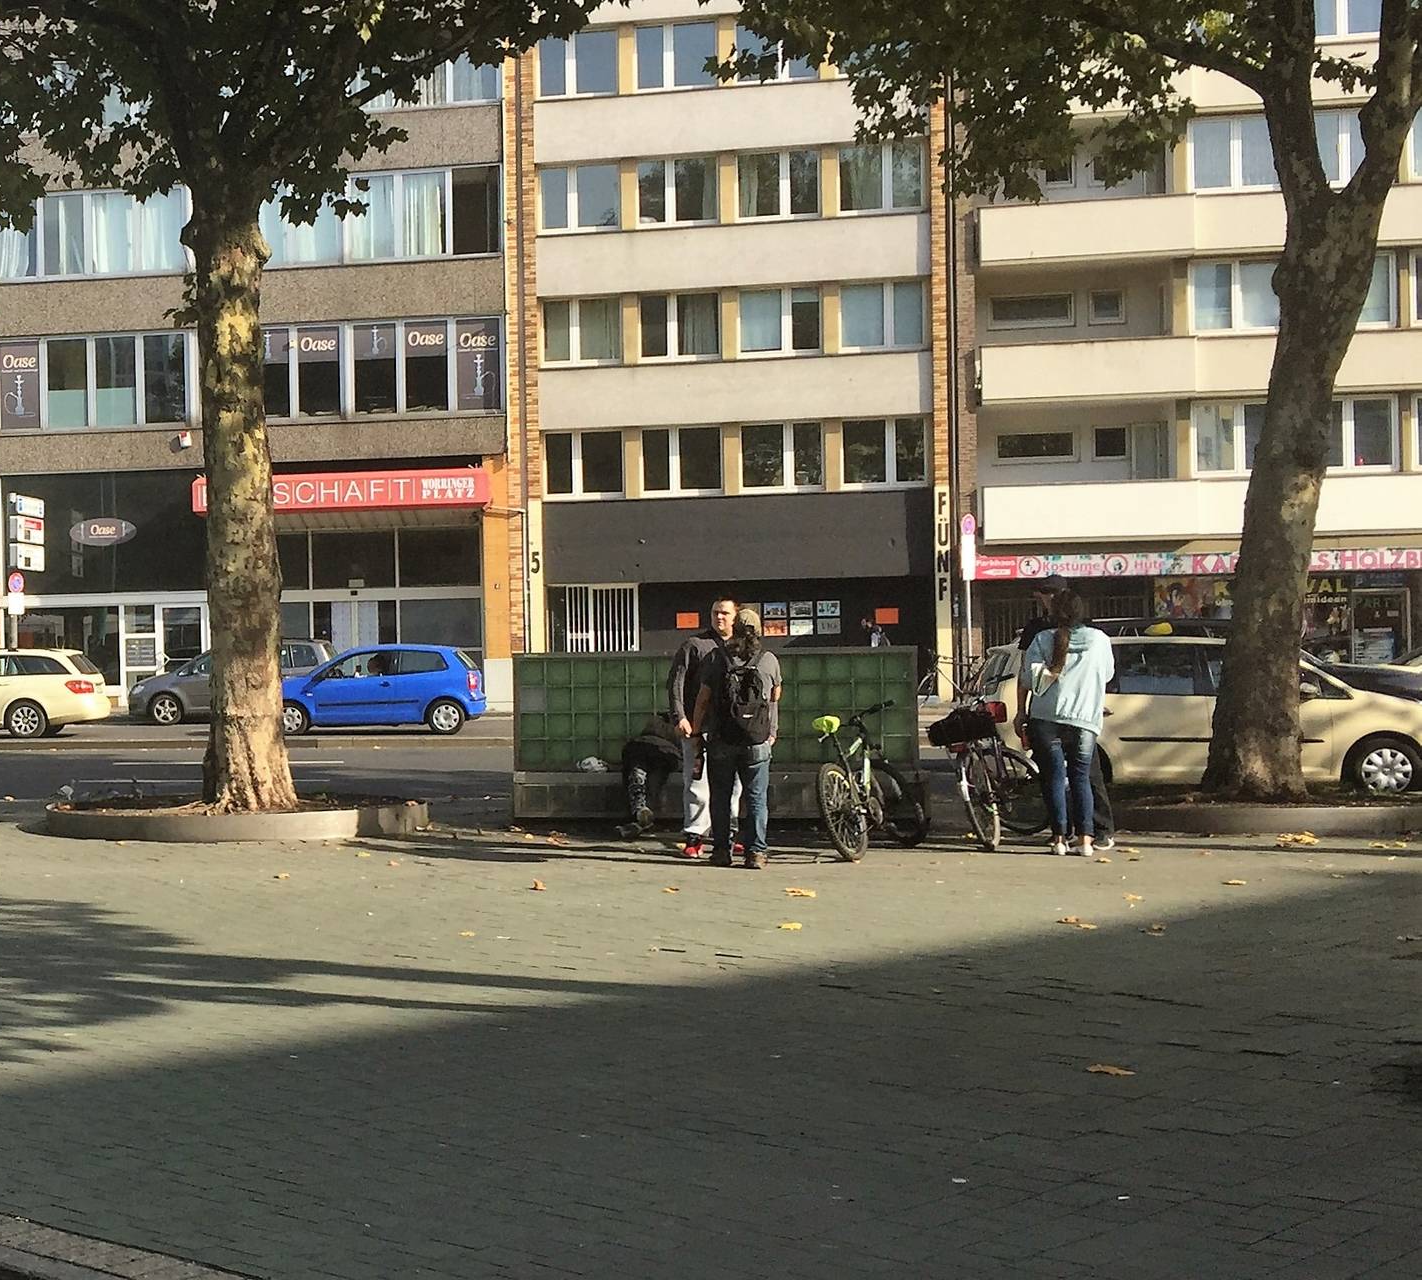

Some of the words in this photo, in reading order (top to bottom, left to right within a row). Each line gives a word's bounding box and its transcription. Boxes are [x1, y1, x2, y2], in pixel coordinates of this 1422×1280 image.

[300, 336, 336, 352] Oase
[407, 331, 444, 347] Oase
[459, 332, 496, 348] Oase
[2, 354, 36, 369] Oase
[421, 477, 475, 490] WORRINGER
[421, 488, 475, 499] PLATZ
[90, 524, 116, 536] Oase
[937, 491, 950, 601] FÜNF
[530, 551, 541, 574] 5
[1339, 549, 1422, 572] HOLZB
